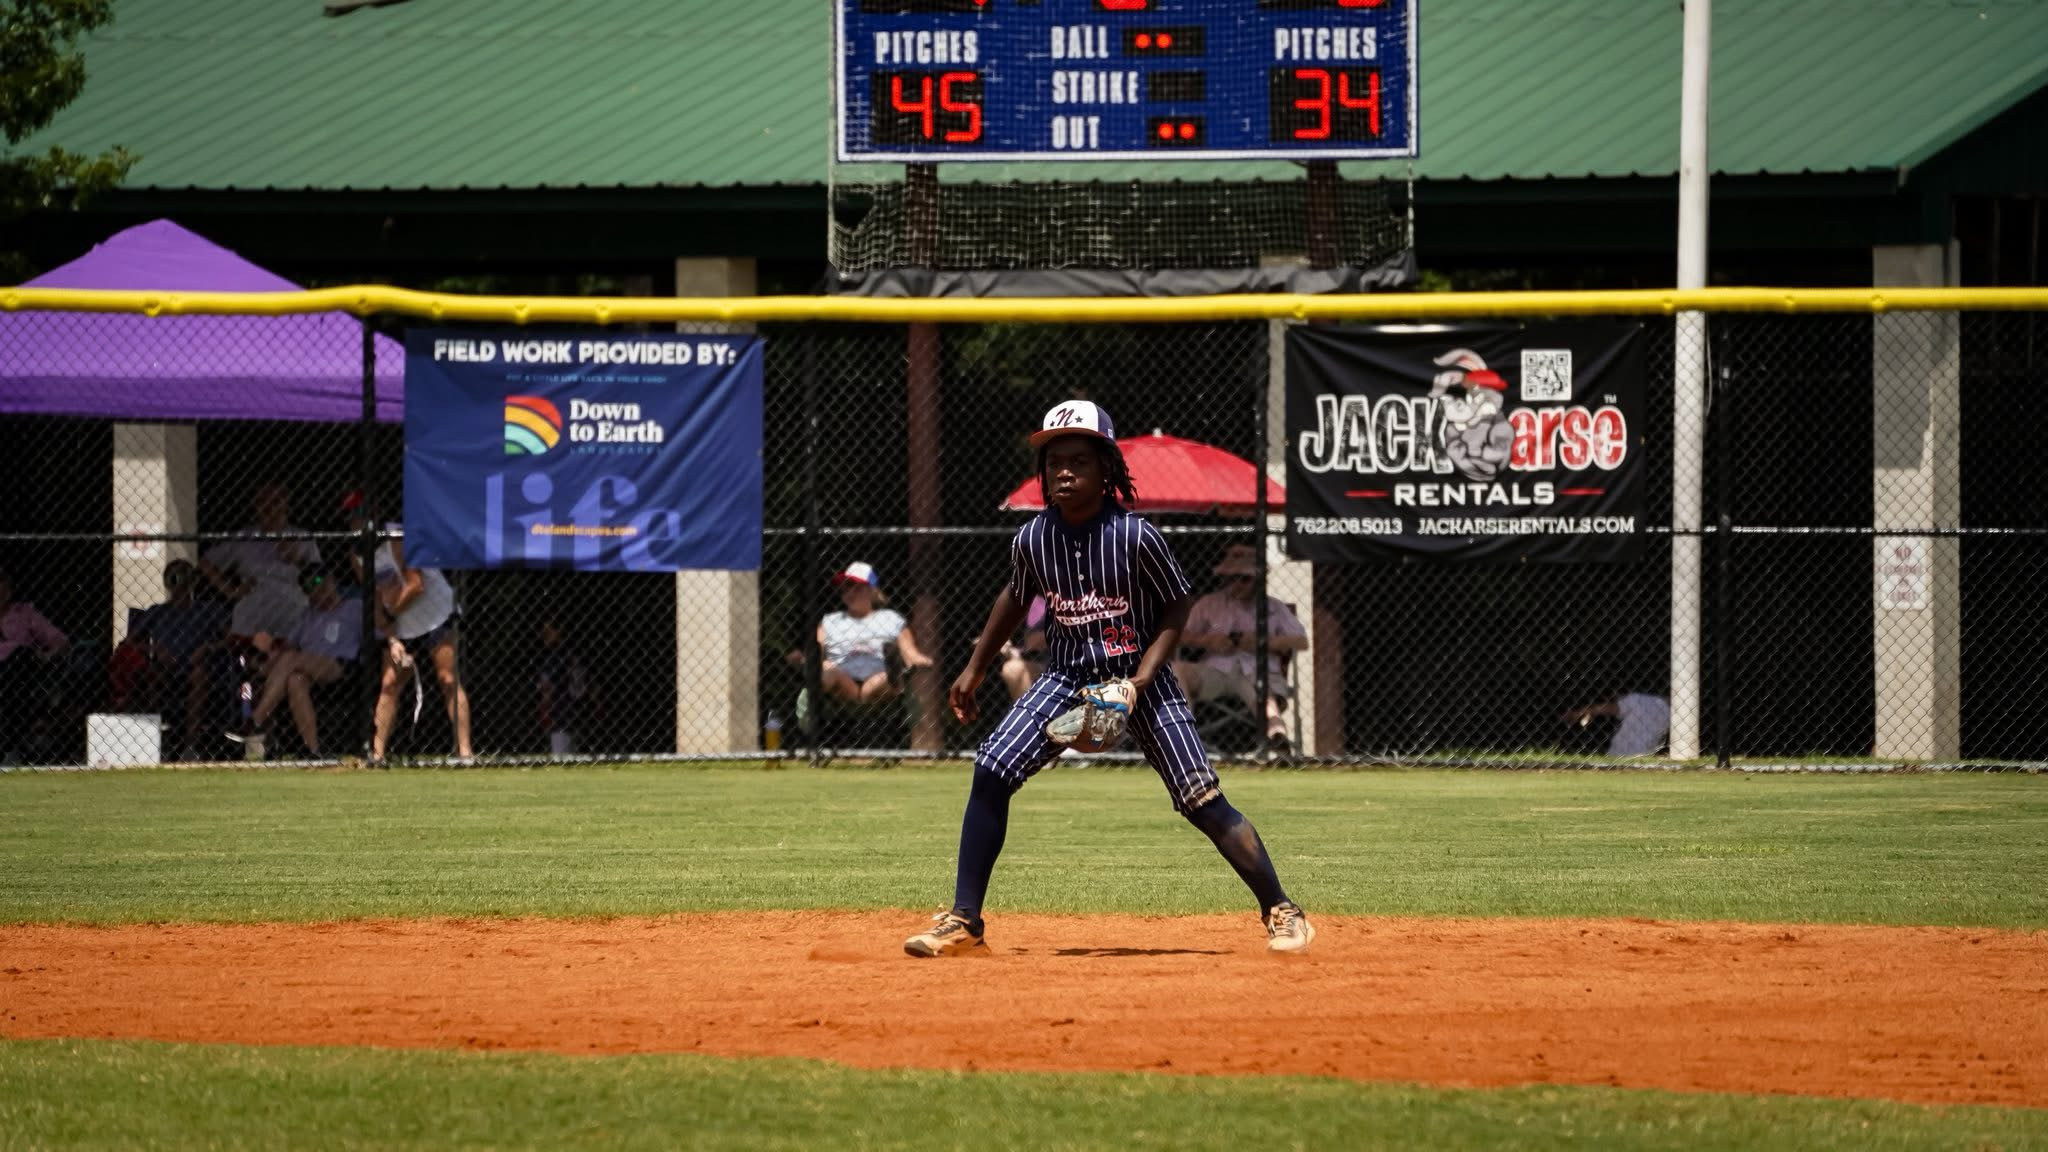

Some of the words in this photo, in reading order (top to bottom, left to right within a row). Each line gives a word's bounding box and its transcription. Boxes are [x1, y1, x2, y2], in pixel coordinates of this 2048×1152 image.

[876, 31, 978, 64] PITCHES
[1051, 26, 1109, 59] BALL
[1275, 27, 1377, 60] PITCHES
[1052, 71, 1139, 104] STRIKE
[1294, 69, 1379, 139] 34
[891, 72, 981, 142] 45
[1052, 116, 1101, 149] OUT
[434, 339, 496, 362] FIELD
[502, 340, 573, 364] WORK
[578, 341, 692, 365] PROVIDED
[697, 343, 737, 365] BY:
[569, 398, 641, 421] Down
[569, 421, 595, 442] to
[597, 419, 664, 443] Earth
[1299, 394, 1454, 474] JACK
[1508, 405, 1628, 472] arse
[1394, 481, 1555, 506] RENTALS
[485, 472, 682, 570] life
[1417, 516, 1635, 535] JACKARSERENTALS.COM
[1046, 588, 1128, 616] Northern
[1103, 625, 1138, 657] 22
